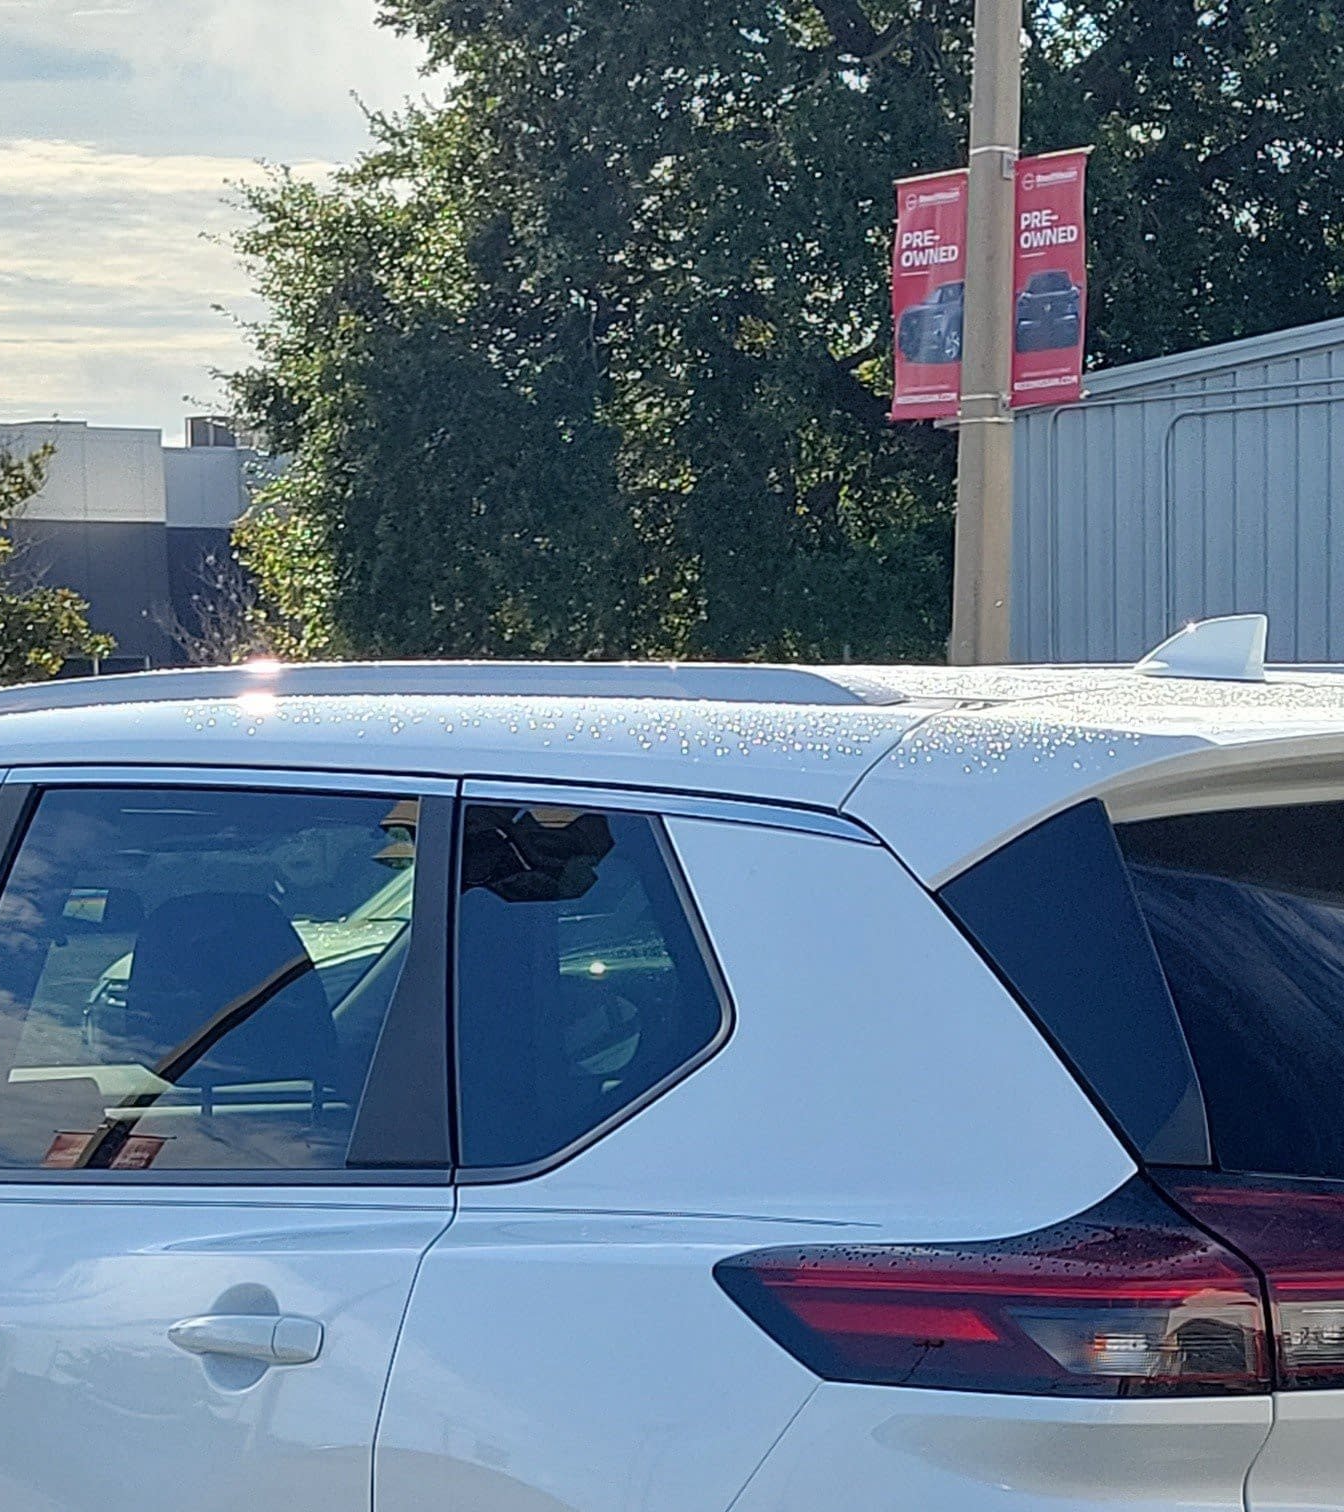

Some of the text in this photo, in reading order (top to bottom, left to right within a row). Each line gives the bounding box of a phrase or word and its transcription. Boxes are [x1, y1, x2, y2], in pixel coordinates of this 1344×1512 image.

[1020, 209, 1059, 230] PRE-
[902, 230, 940, 249] PRE-
[1020, 225, 1078, 248] OWNED
[901, 245, 959, 267] OWNED
